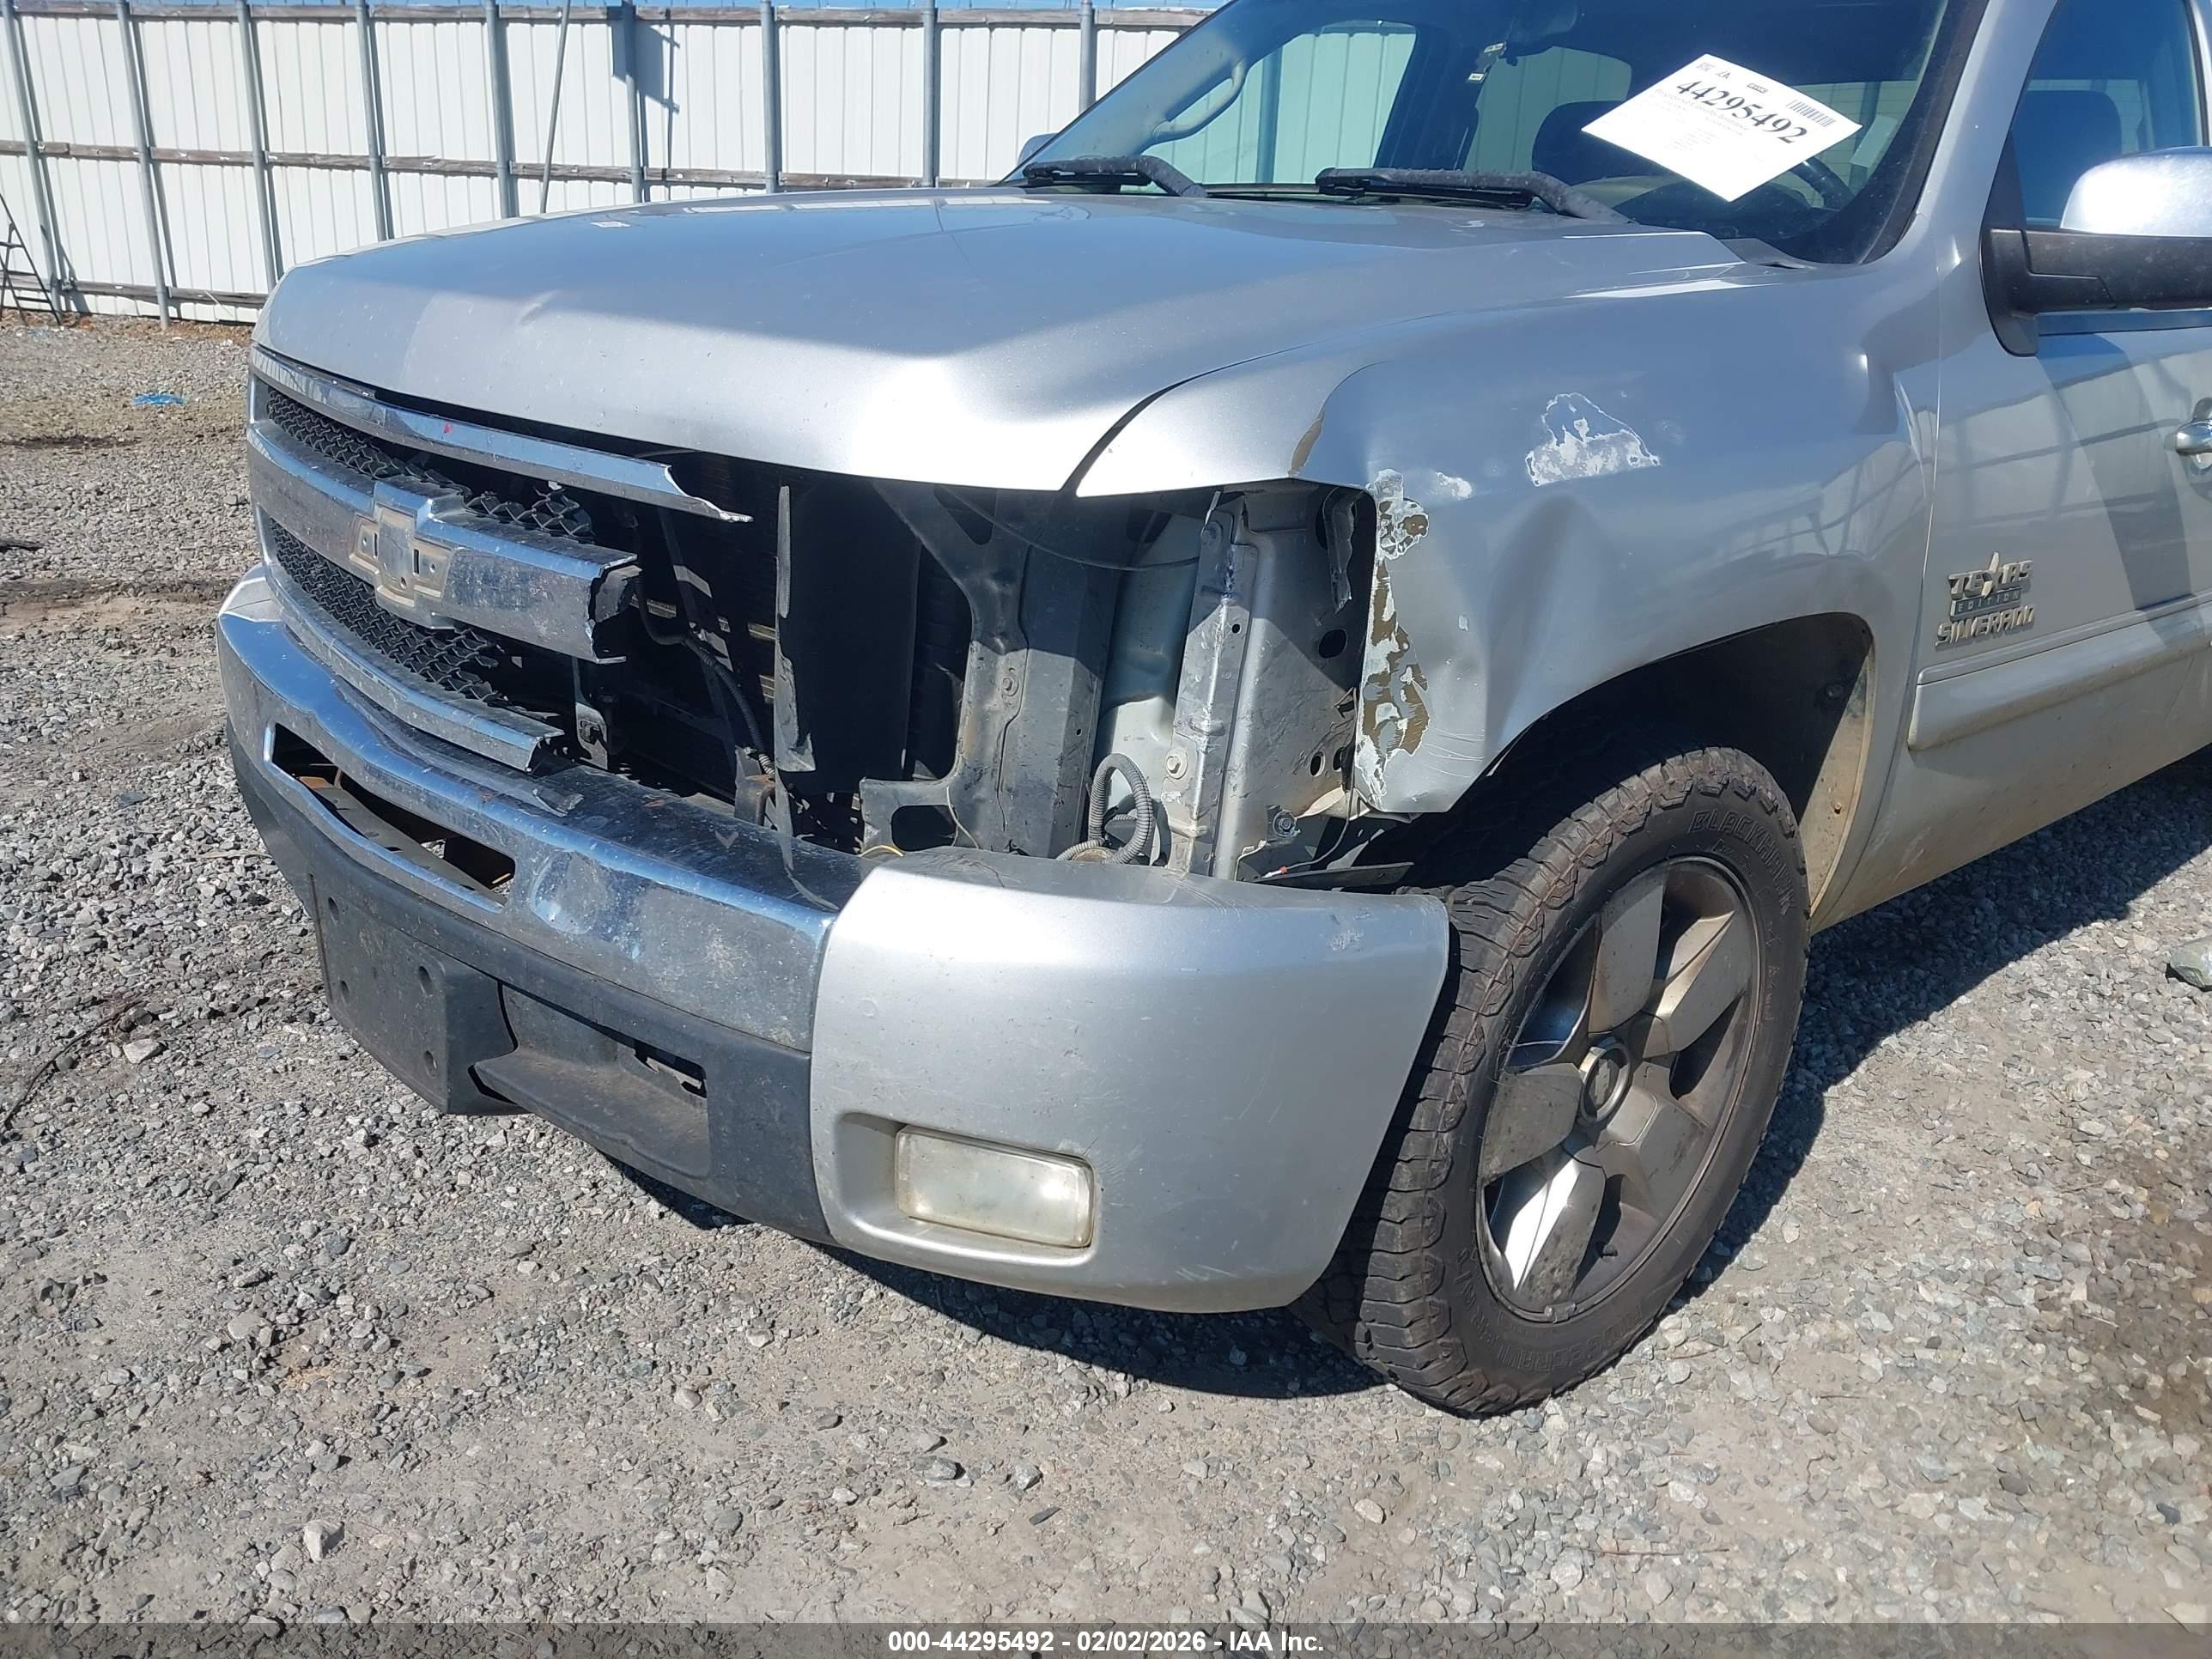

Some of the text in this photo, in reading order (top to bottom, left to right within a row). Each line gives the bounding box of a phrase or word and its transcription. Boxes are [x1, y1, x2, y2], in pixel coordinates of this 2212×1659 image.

[1676, 80, 1808, 143] 44295492
[1948, 552, 2033, 599] TEXAS
[1936, 604, 2034, 647] SILVERADO
[1956, 592, 2021, 613] EDITION
[1688, 810, 1796, 916] BLACKHAWK
